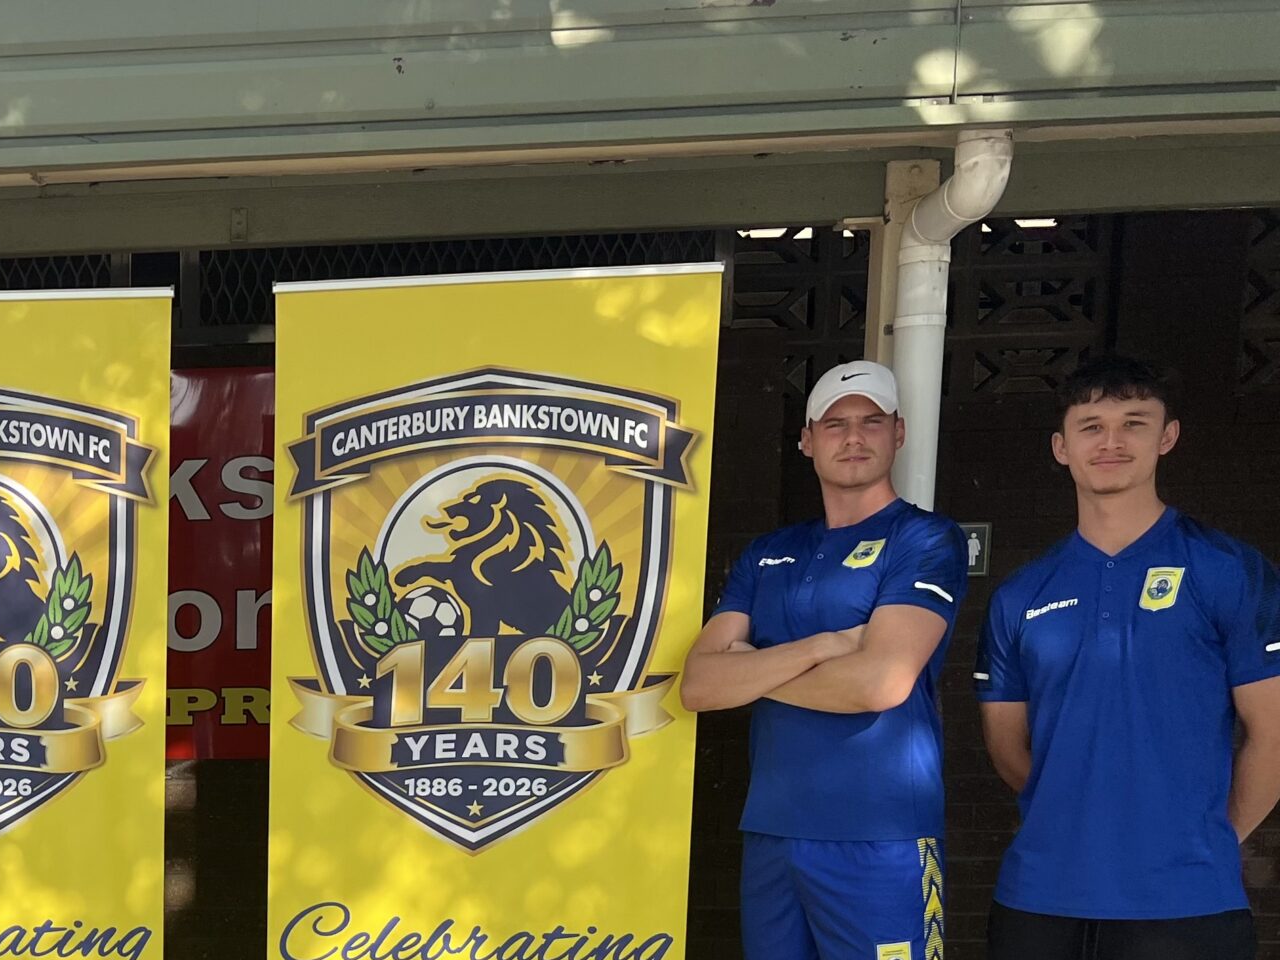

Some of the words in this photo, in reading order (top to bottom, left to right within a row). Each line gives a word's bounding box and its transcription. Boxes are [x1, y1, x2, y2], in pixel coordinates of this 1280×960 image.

[331, 404, 470, 458] CANTERBURY
[473, 403, 619, 441] BANKSTOWN
[623, 419, 648, 449] FC
[88, 432, 111, 463] FC
[375, 636, 583, 728] 140
[403, 732, 548, 761] YEARS
[404, 777, 463, 797] 1886
[482, 777, 548, 797] 2026
